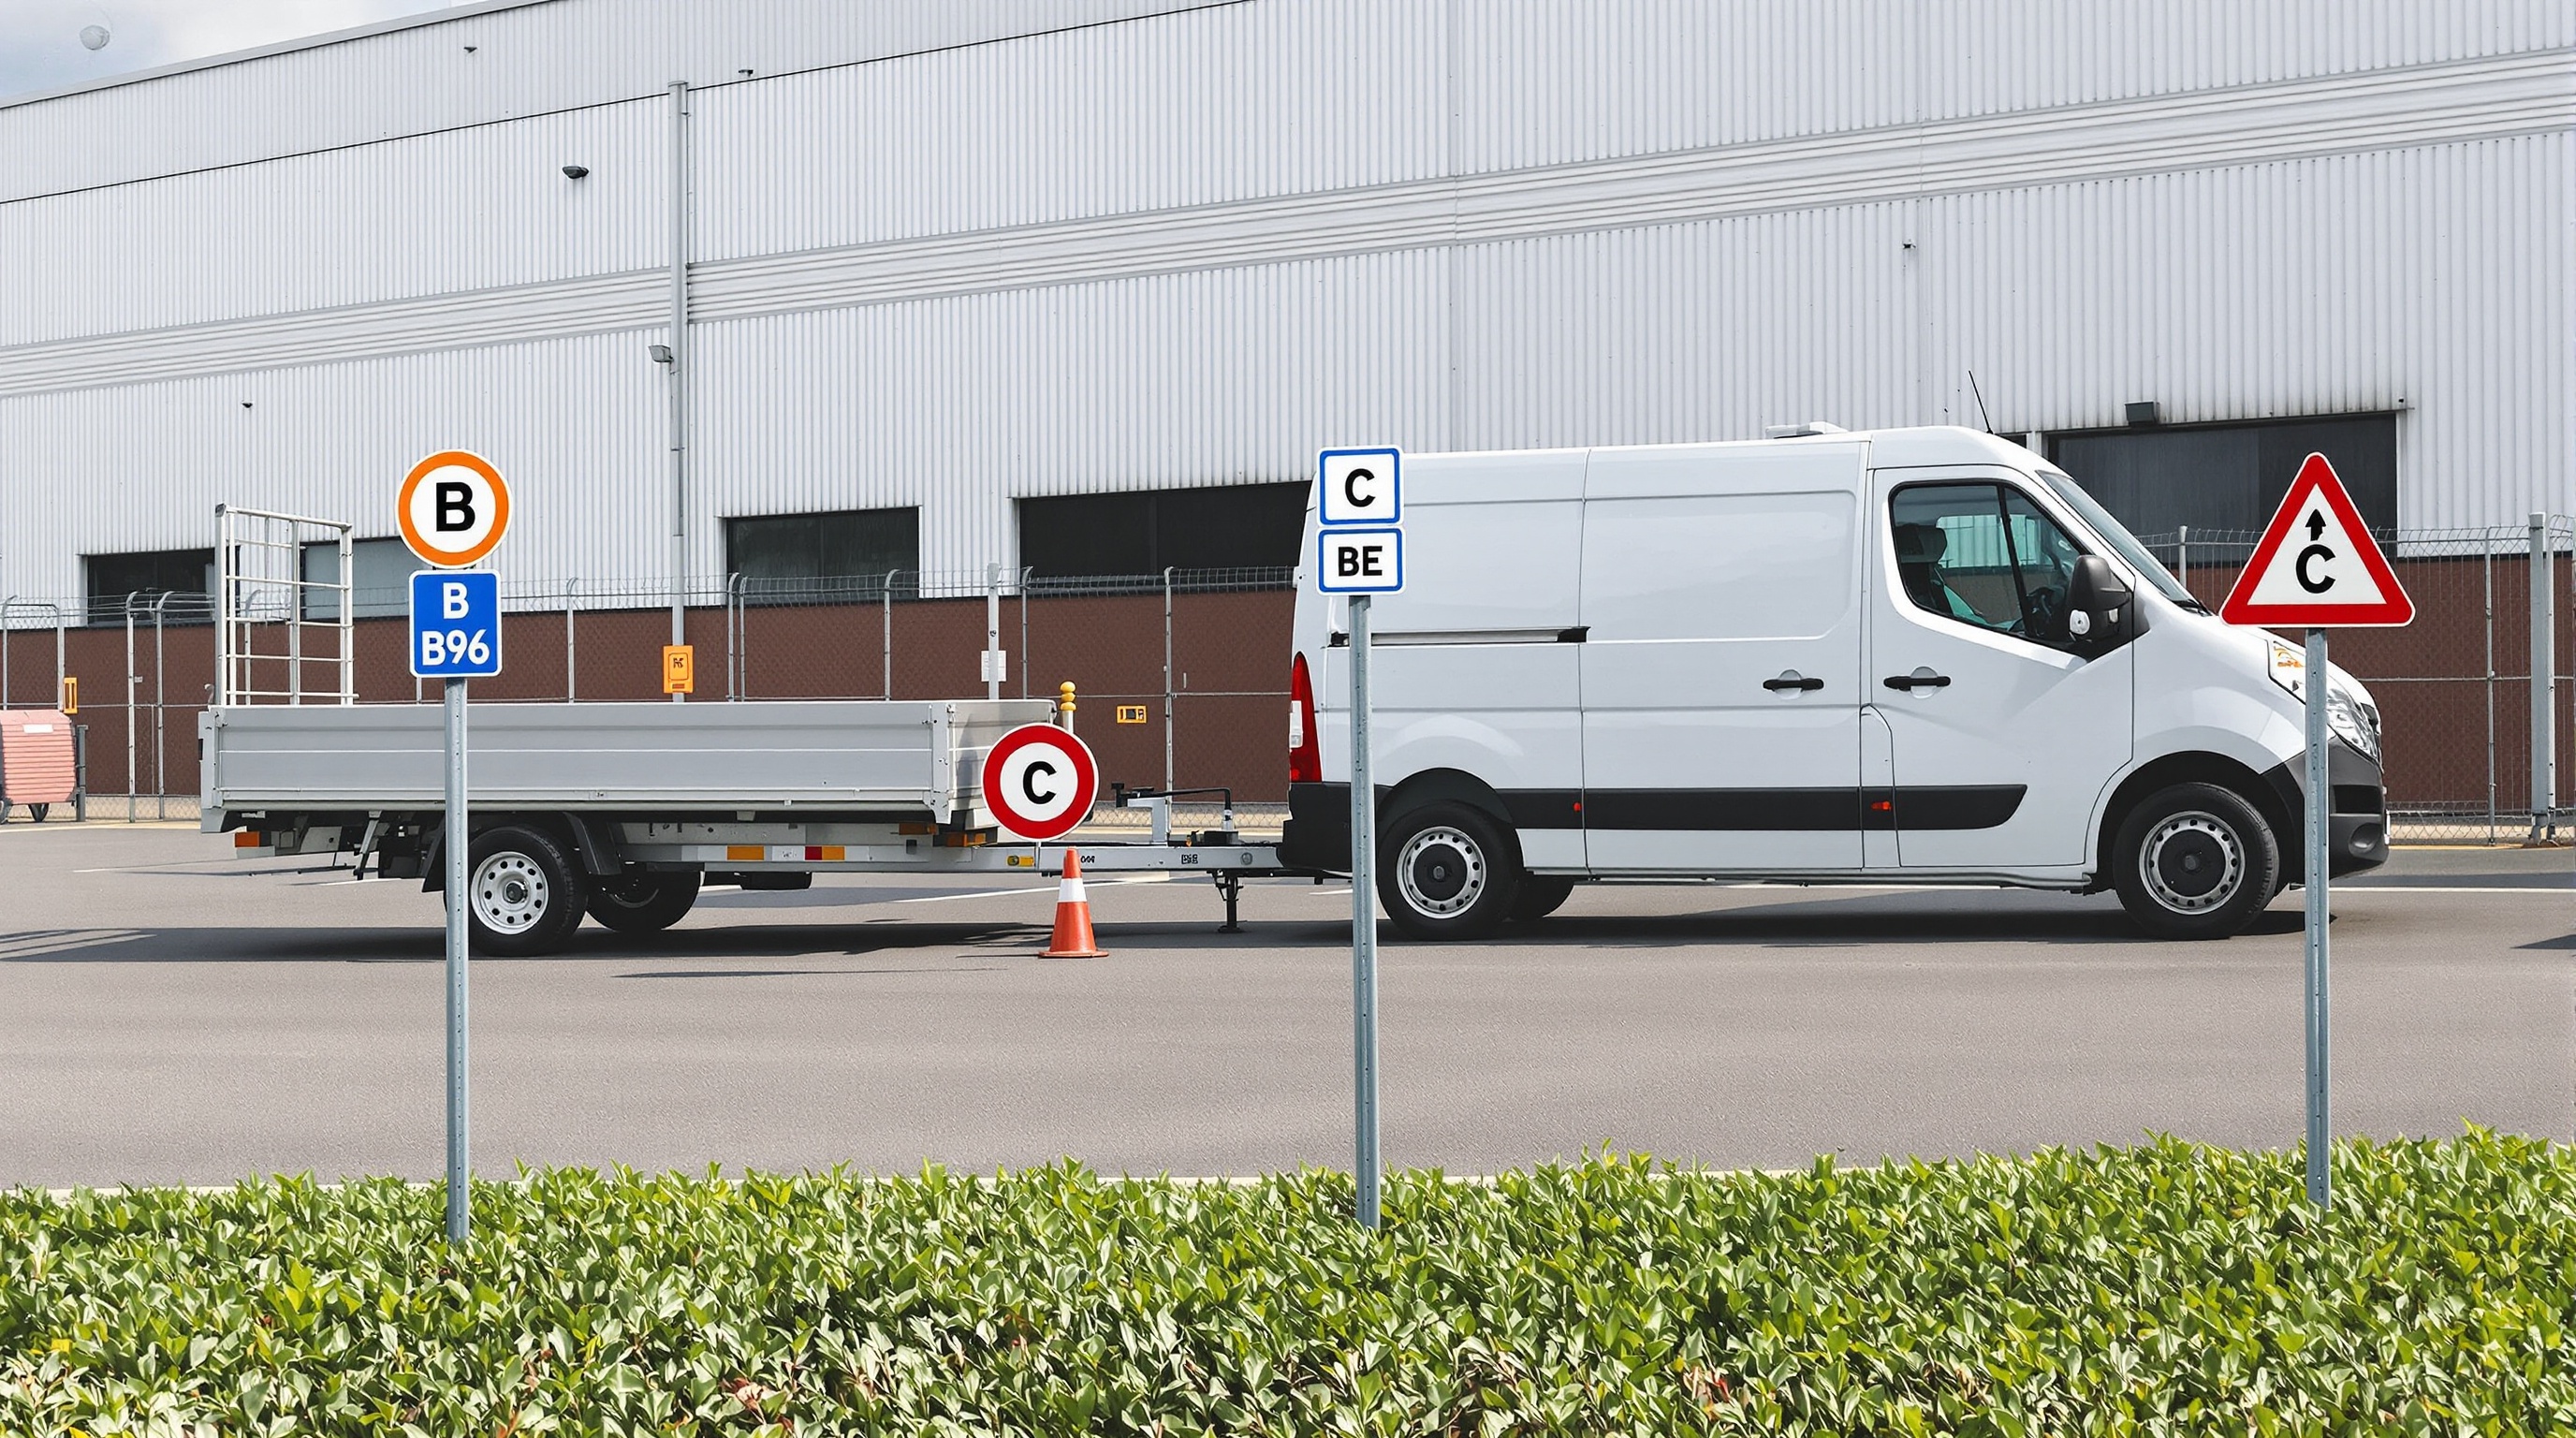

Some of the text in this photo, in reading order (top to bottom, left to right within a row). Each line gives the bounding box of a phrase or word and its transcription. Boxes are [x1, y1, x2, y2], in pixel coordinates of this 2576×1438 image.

[435, 481, 476, 532] B
[1344, 468, 1376, 507] C
[1338, 545, 1384, 577] BE
[2295, 543, 2336, 594] C
[443, 581, 470, 619] B
[421, 629, 490, 666] B96
[1022, 760, 1057, 805] C
